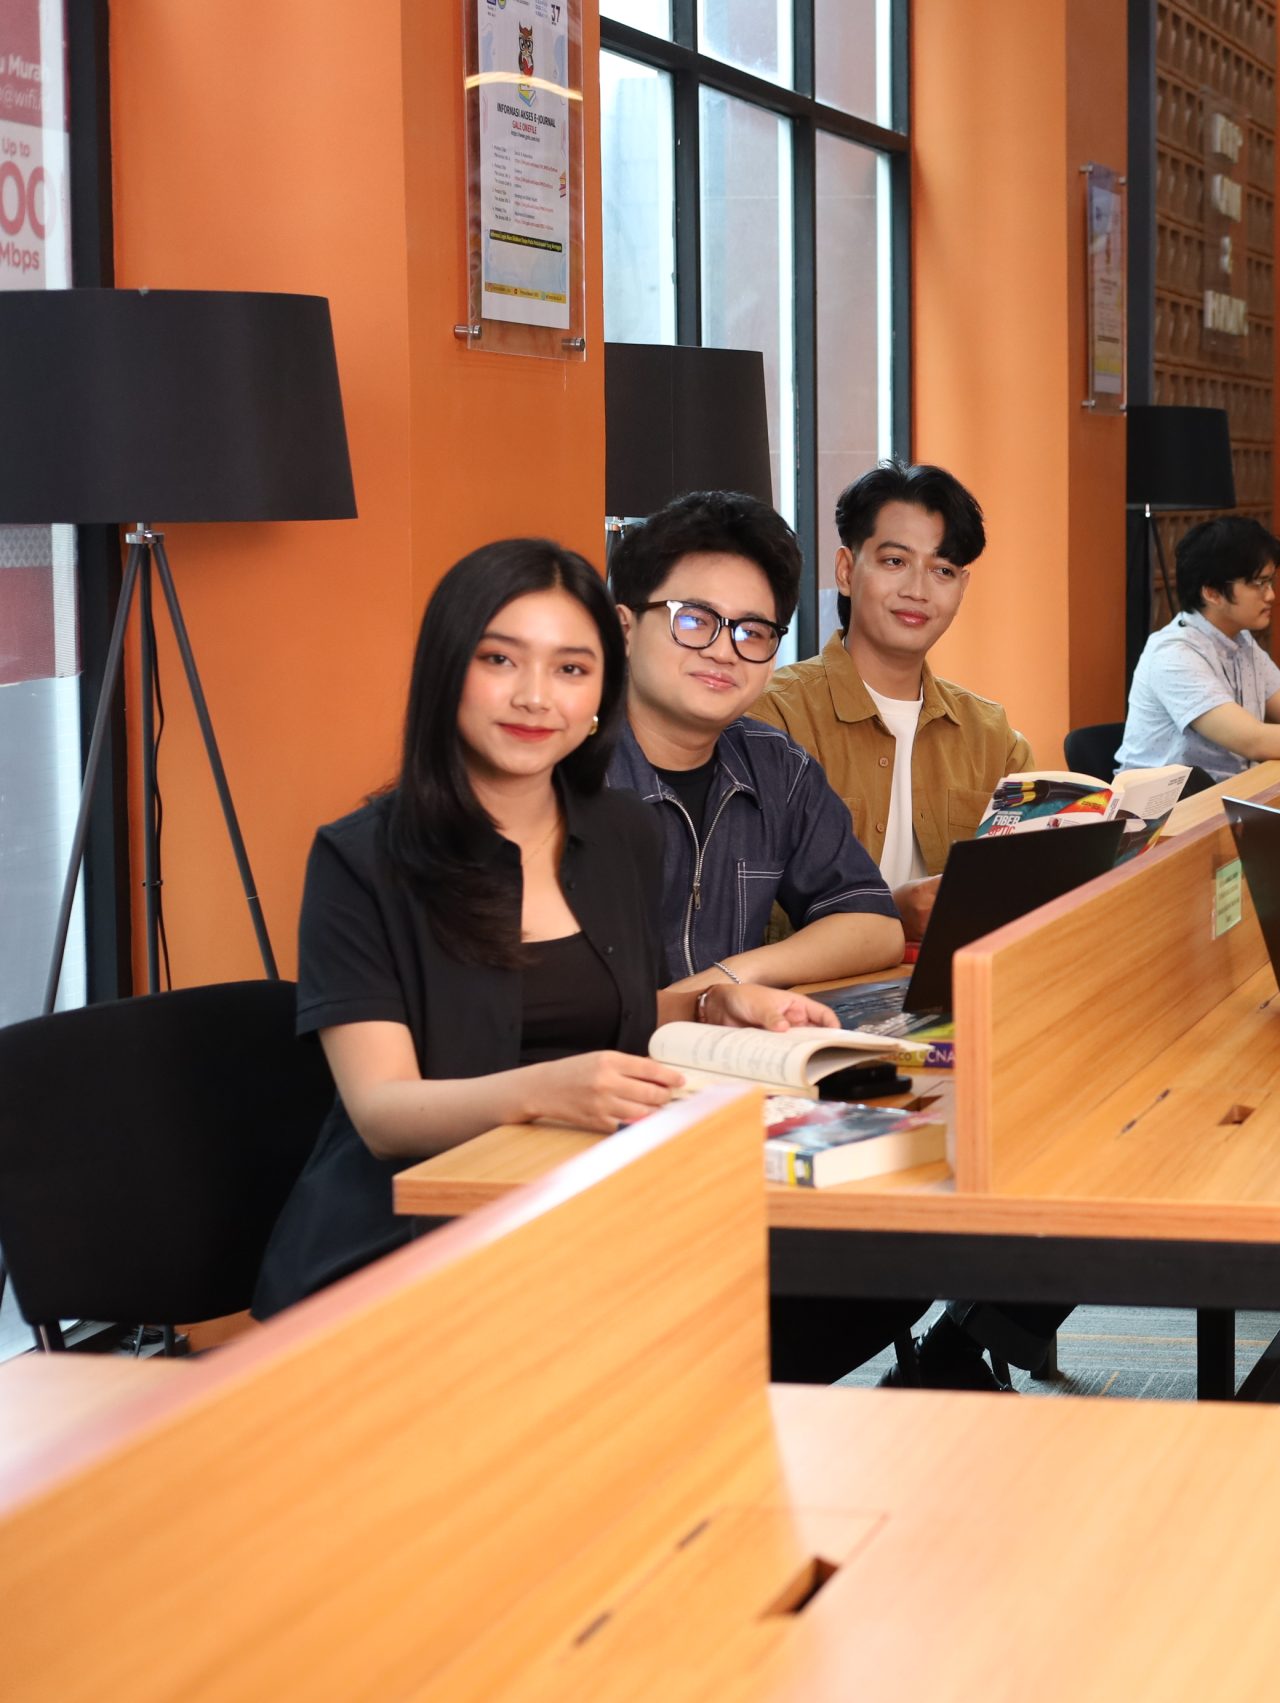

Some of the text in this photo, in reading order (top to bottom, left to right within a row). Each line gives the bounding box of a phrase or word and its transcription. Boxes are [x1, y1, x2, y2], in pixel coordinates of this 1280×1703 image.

[497, 102, 520, 118] INFORMASI
[521, 109, 533, 122] AKSES
[2, 138, 31, 159] Up to
[0, 241, 40, 273] Mbps
[992, 815, 1021, 826] FIBER
[988, 825, 1016, 837] OPTIC
